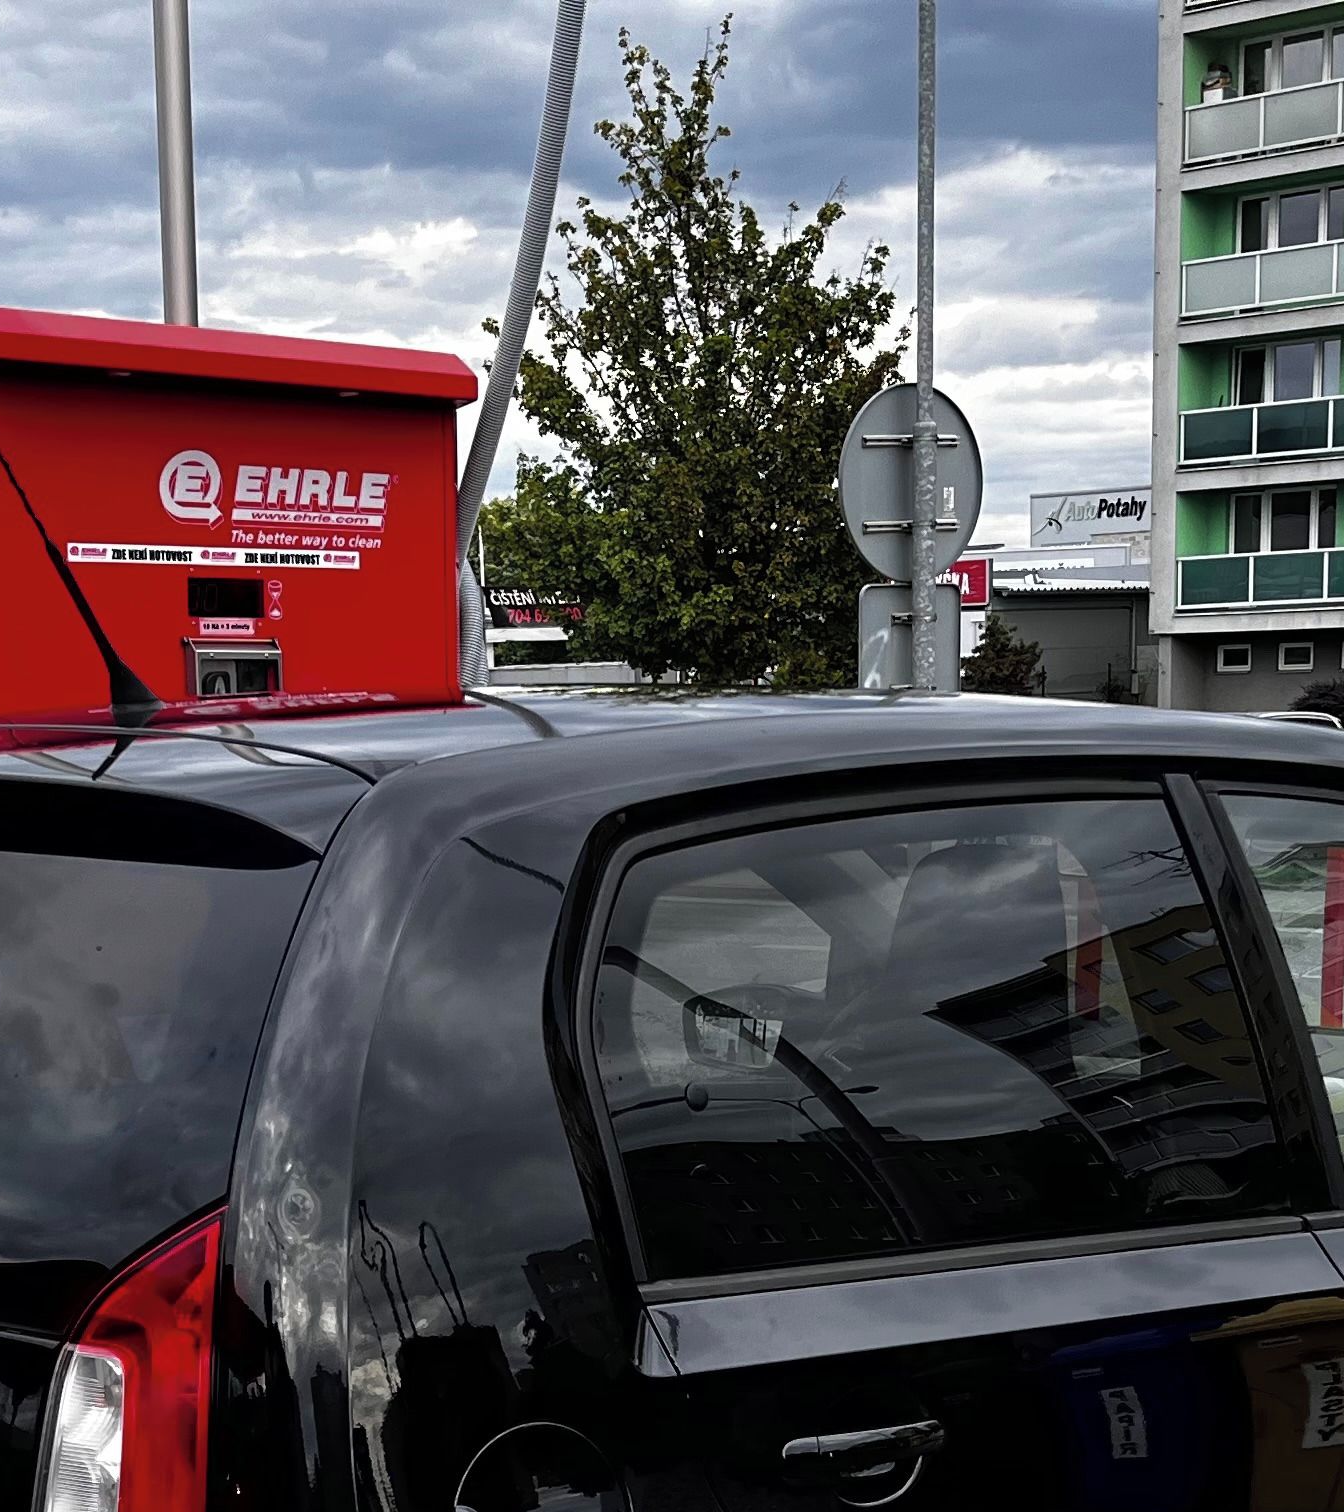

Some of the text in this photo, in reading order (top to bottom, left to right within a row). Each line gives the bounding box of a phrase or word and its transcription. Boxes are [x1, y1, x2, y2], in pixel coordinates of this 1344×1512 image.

[234, 465, 391, 515] EHRLE
[251, 511, 369, 525] www.ehrle.com
[231, 530, 381, 550] The better way to clean
[112, 548, 127, 560] ZDE
[244, 552, 258, 564] ZDE
[489, 589, 536, 606] ČIŠTĚNÍ
[508, 608, 532, 624] 704
